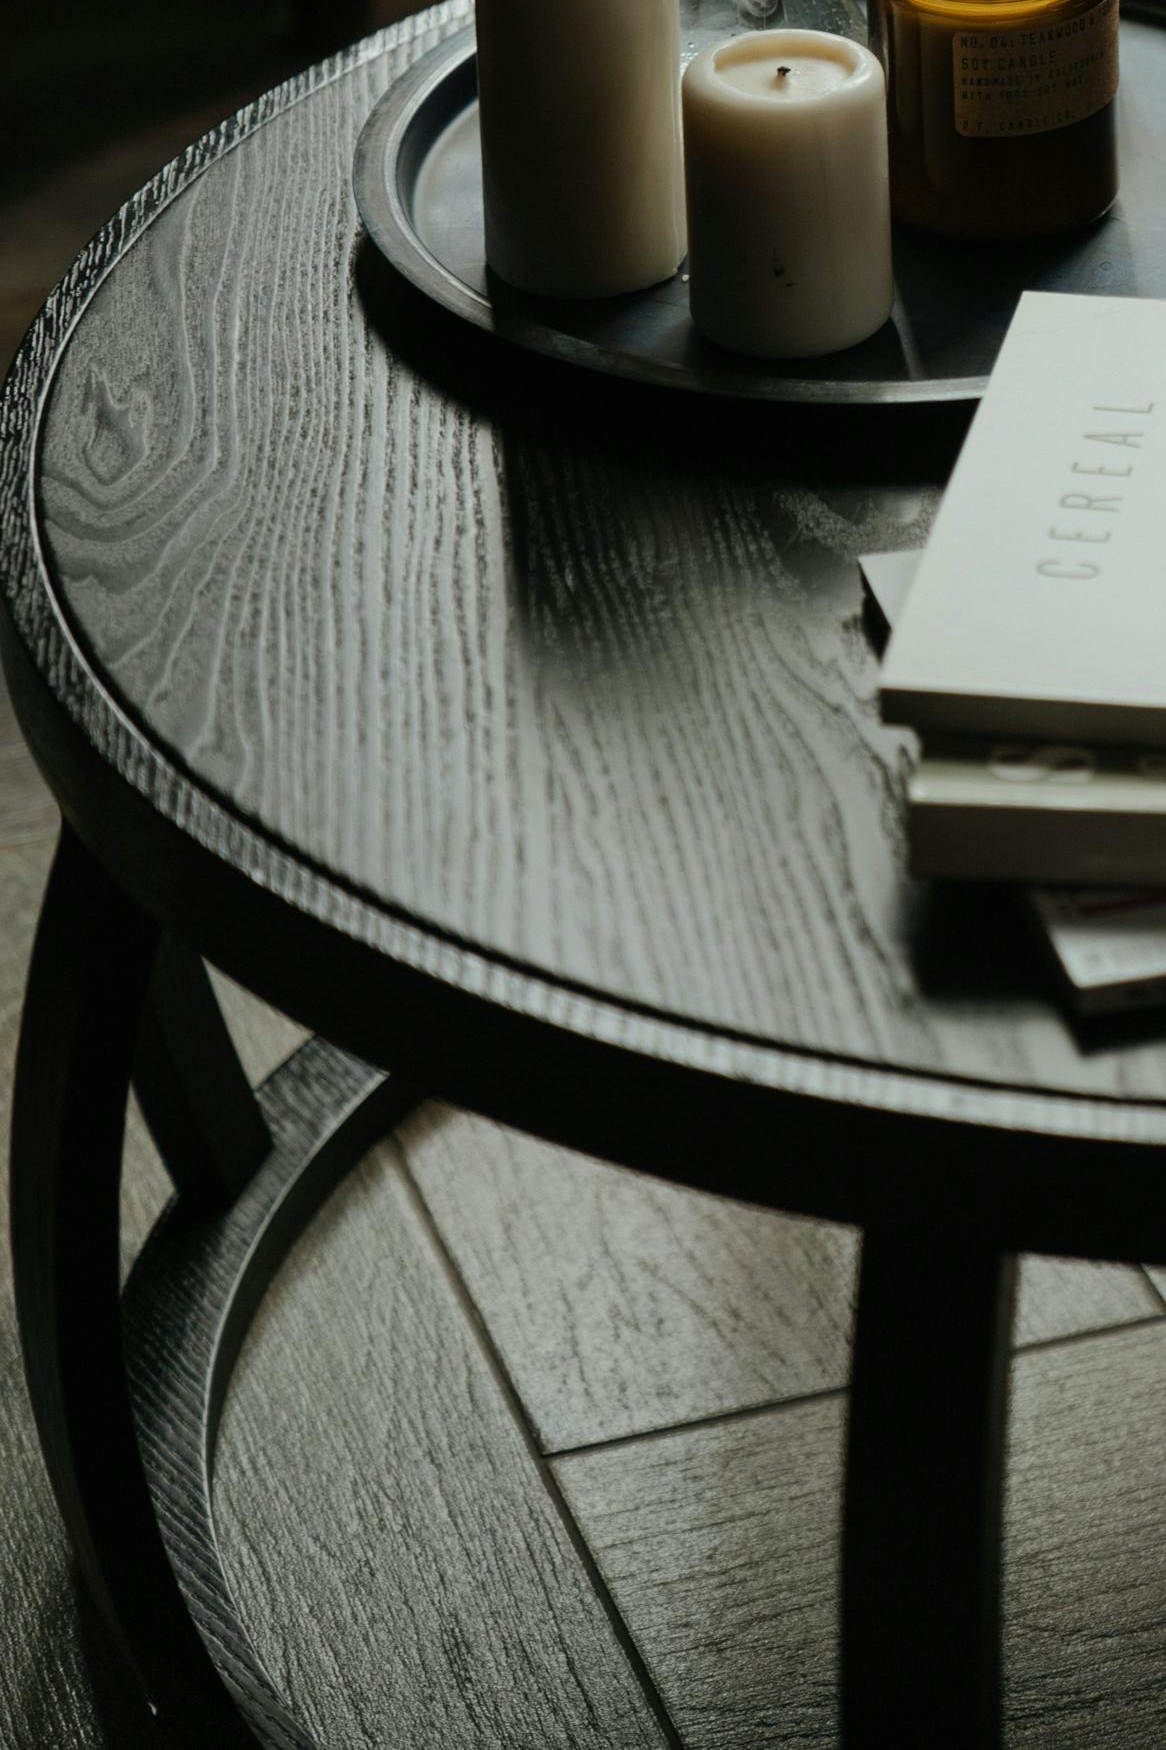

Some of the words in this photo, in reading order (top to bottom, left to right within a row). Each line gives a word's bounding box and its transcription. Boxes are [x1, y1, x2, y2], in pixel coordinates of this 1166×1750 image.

[960, 36, 984, 49] NO.
[1020, 19, 1086, 46] TEAKWOOD
[961, 57, 988, 71] SOY
[997, 50, 1057, 71] CANDLE
[961, 75, 1020, 86] HANDMADE
[1030, 73, 1041, 84] IN
[961, 91, 992, 101] WITH
[1000, 89, 1030, 101] 100%
[1037, 83, 1057, 97] SOY
[999, 116, 1050, 132] CANDLE
[1035, 402, 1155, 581] CEREAL
